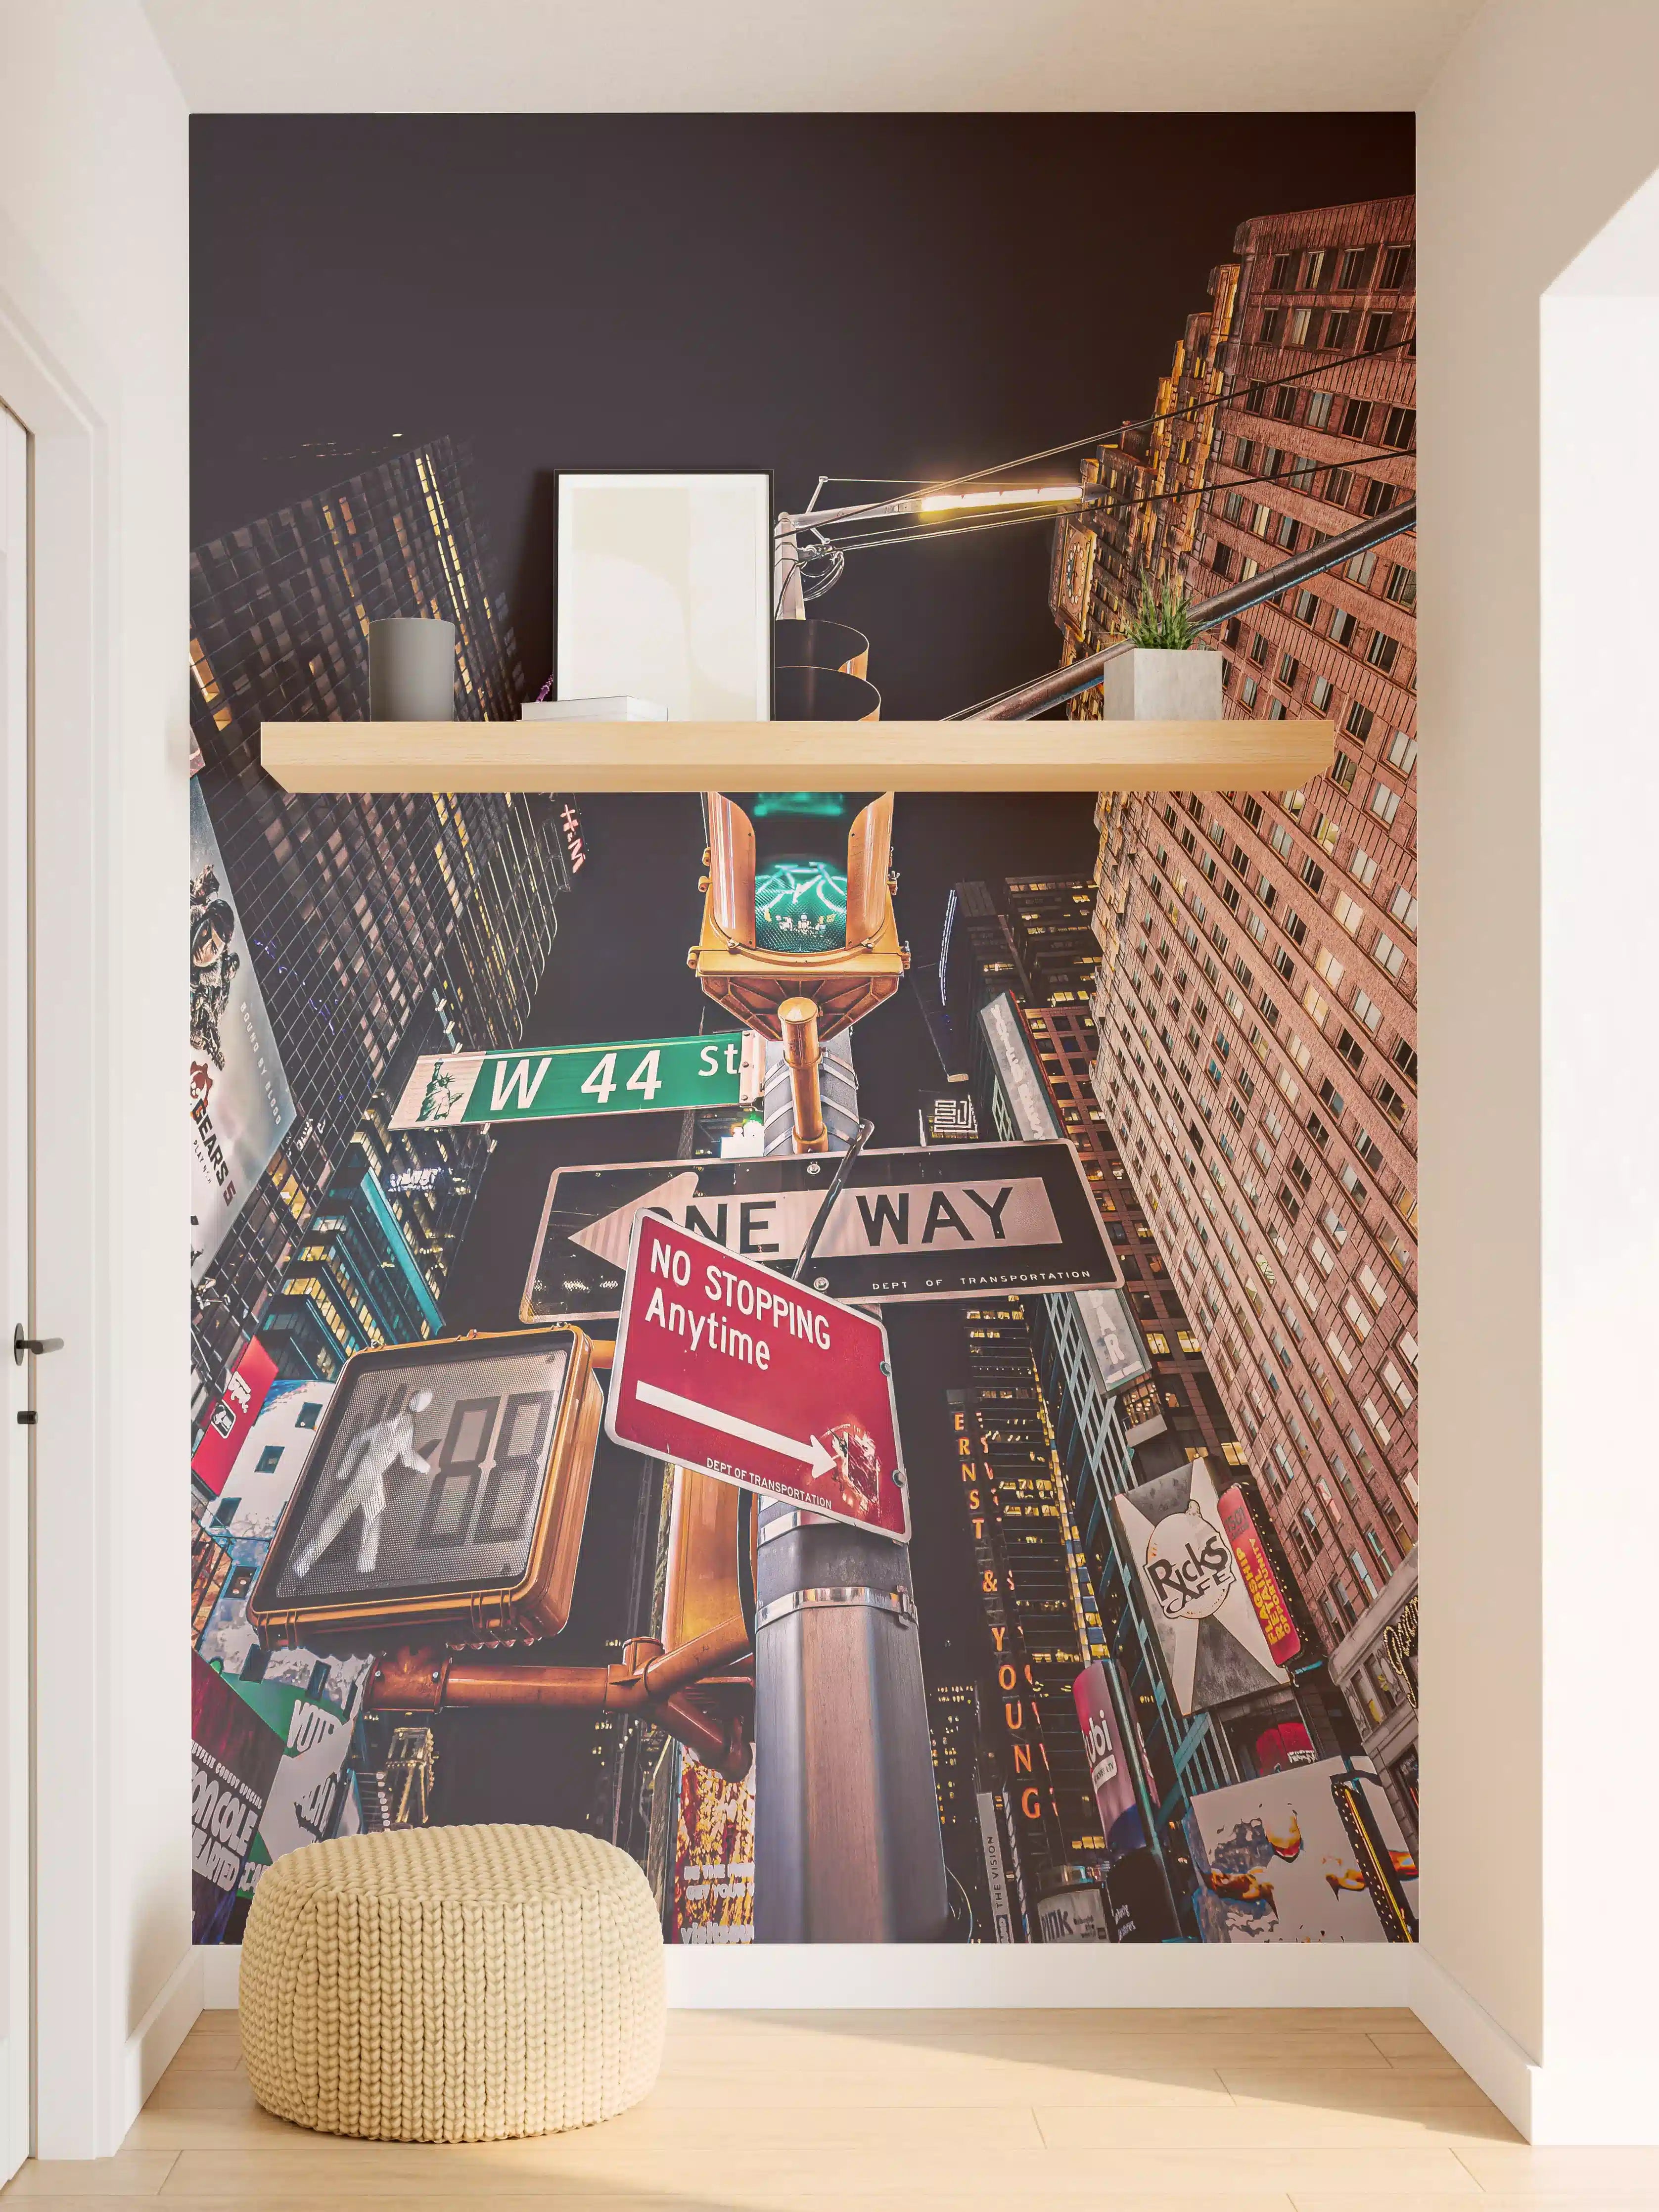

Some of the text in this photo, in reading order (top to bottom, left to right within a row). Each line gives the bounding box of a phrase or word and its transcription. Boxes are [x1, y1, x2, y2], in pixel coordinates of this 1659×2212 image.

[490, 1044, 738, 1110] W 44 St
[191, 1098, 236, 1206] GEARS 5
[629, 1187, 1014, 1254] NE WAY
[650, 1238, 830, 1350] NO STOPPING
[873, 1281, 908, 1290] DEPT
[960, 1271, 1091, 1285] TRANSPORTATION
[645, 1287, 770, 1371] Anytime
[707, 1457, 832, 1509] DEPT OF TRANSPORTATION
[954, 1412, 1041, 1819] ERNST & YOUNG
[191, 1761, 219, 1829] ON
[211, 1791, 258, 1856] COLE
[191, 1824, 240, 1891] EARTED
[987, 1836, 1003, 1909] THE VISION
